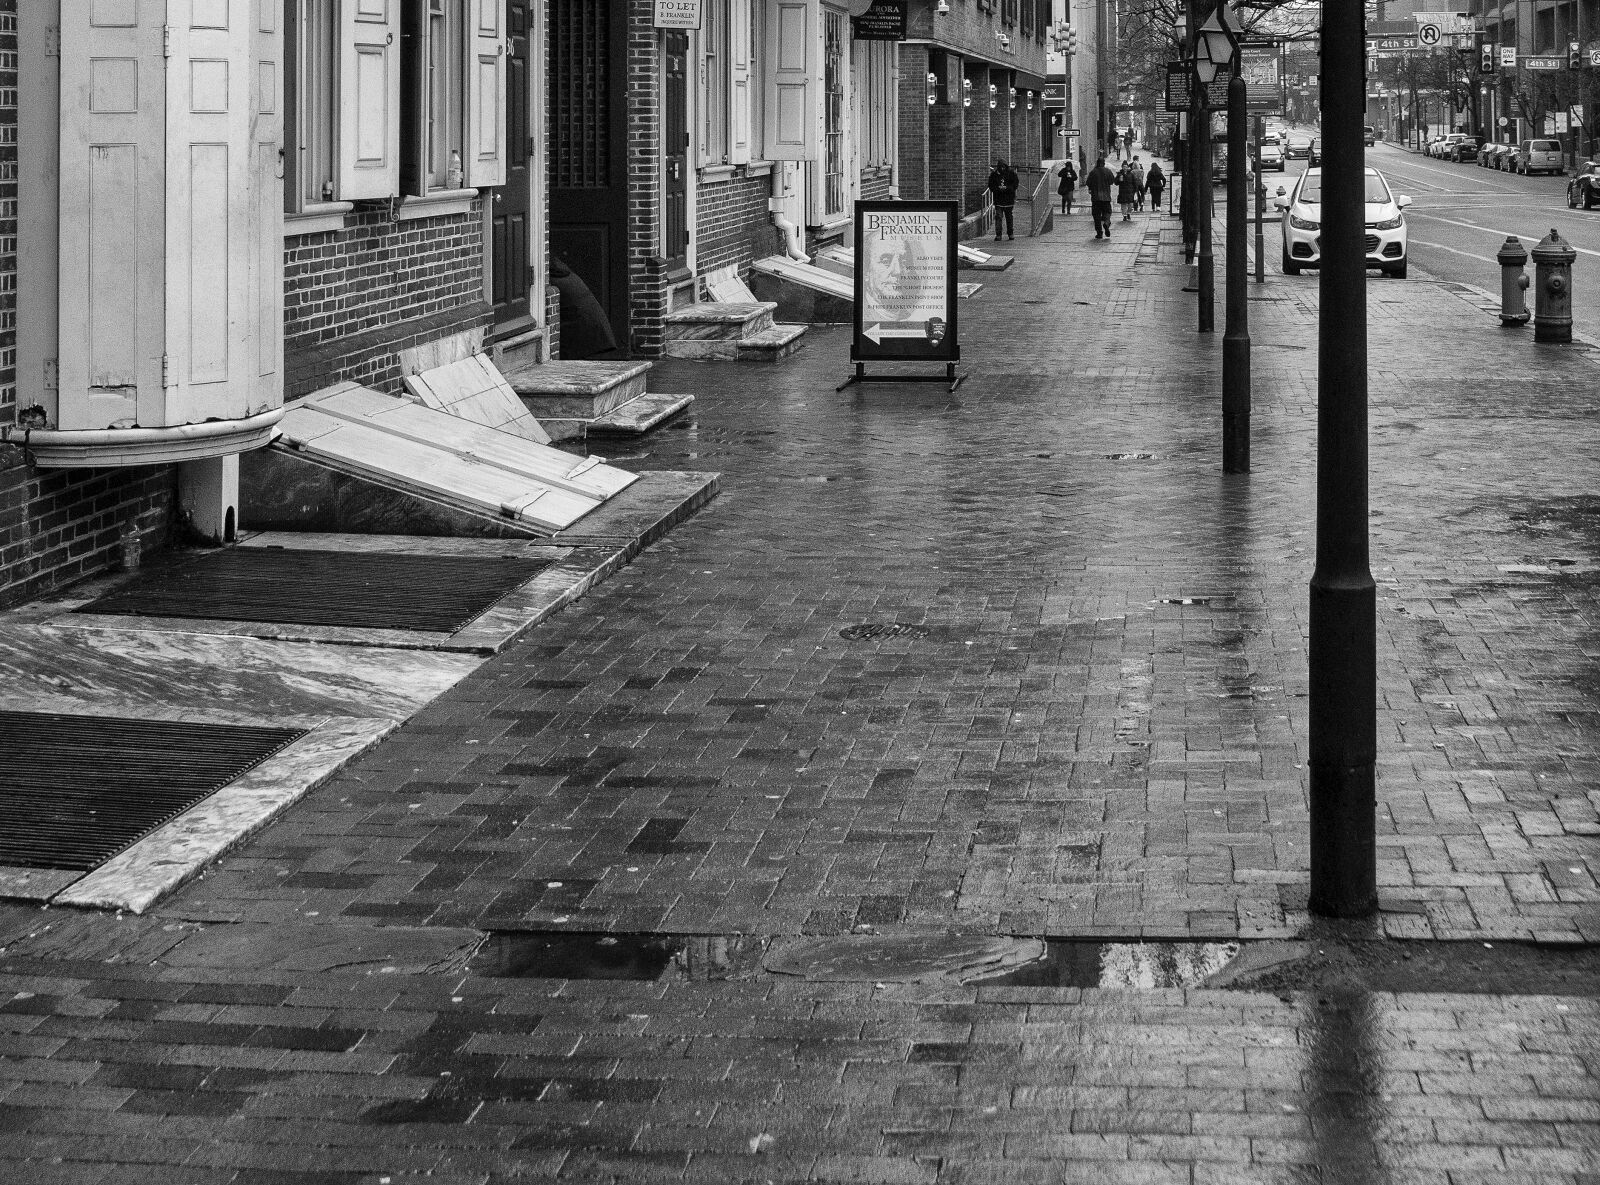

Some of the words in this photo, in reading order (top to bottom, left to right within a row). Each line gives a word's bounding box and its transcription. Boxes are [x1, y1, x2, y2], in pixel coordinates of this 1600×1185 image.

[660, 2, 674, 10] TO
[869, 5, 900, 13] URORA
[1381, 39, 1400, 48] 4th
[1403, 39, 1414, 47] St
[1529, 59, 1544, 67] 4th
[1547, 59, 1556, 67] St
[867, 214, 930, 230] BENJAMIN
[880, 225, 943, 241] FRANKLIN
